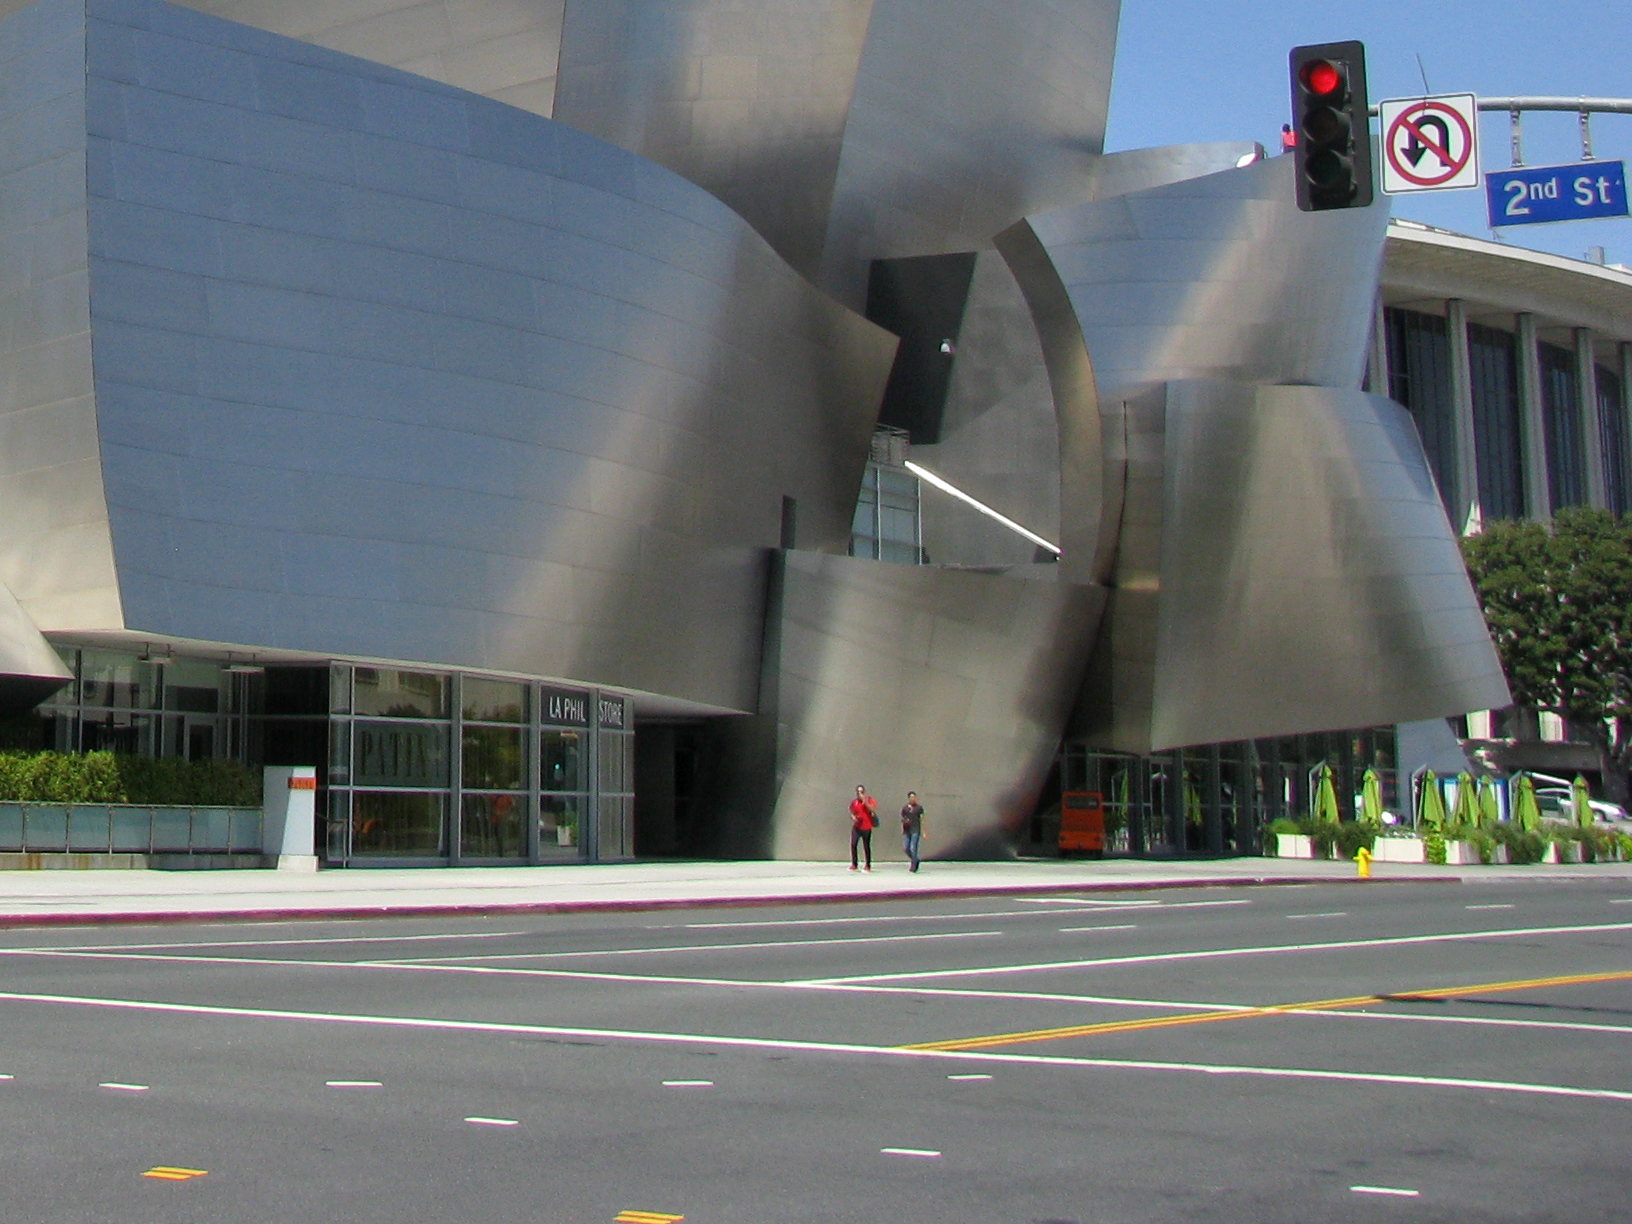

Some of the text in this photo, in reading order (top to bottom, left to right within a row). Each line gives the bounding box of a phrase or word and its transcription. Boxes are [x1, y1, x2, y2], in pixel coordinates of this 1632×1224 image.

[1503, 176, 1612, 216] 2nd St
[549, 696, 562, 719] LA
[564, 697, 586, 722] PHIL
